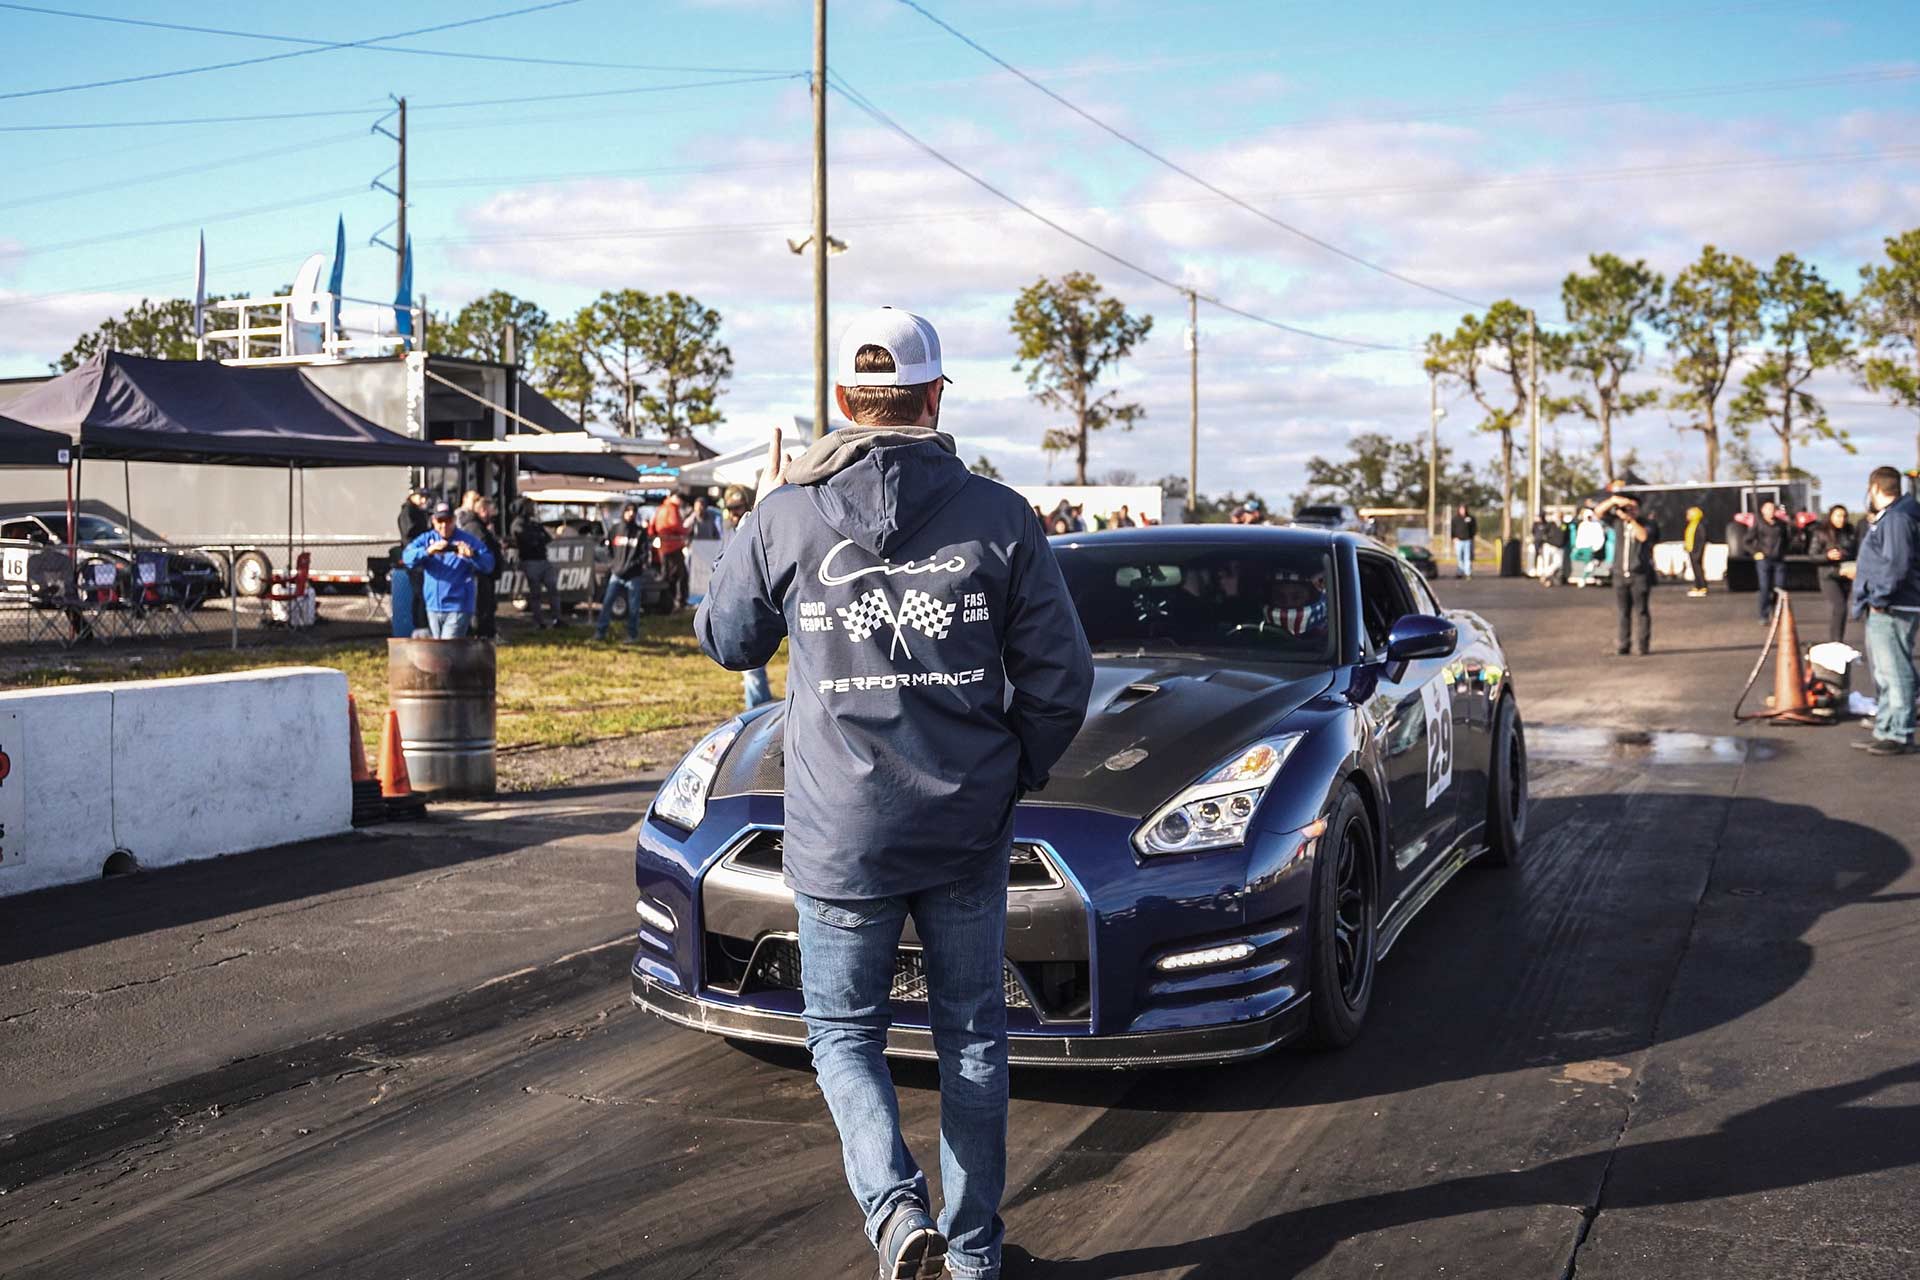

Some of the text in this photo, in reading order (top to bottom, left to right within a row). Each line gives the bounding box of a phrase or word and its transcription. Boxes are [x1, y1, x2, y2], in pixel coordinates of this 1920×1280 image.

[8, 559, 23, 576] 16
[818, 538, 966, 587] Cicio
[963, 607, 990, 623] CARS
[818, 668, 985, 694] PERFORMANCE
[1429, 708, 1451, 790] 29
